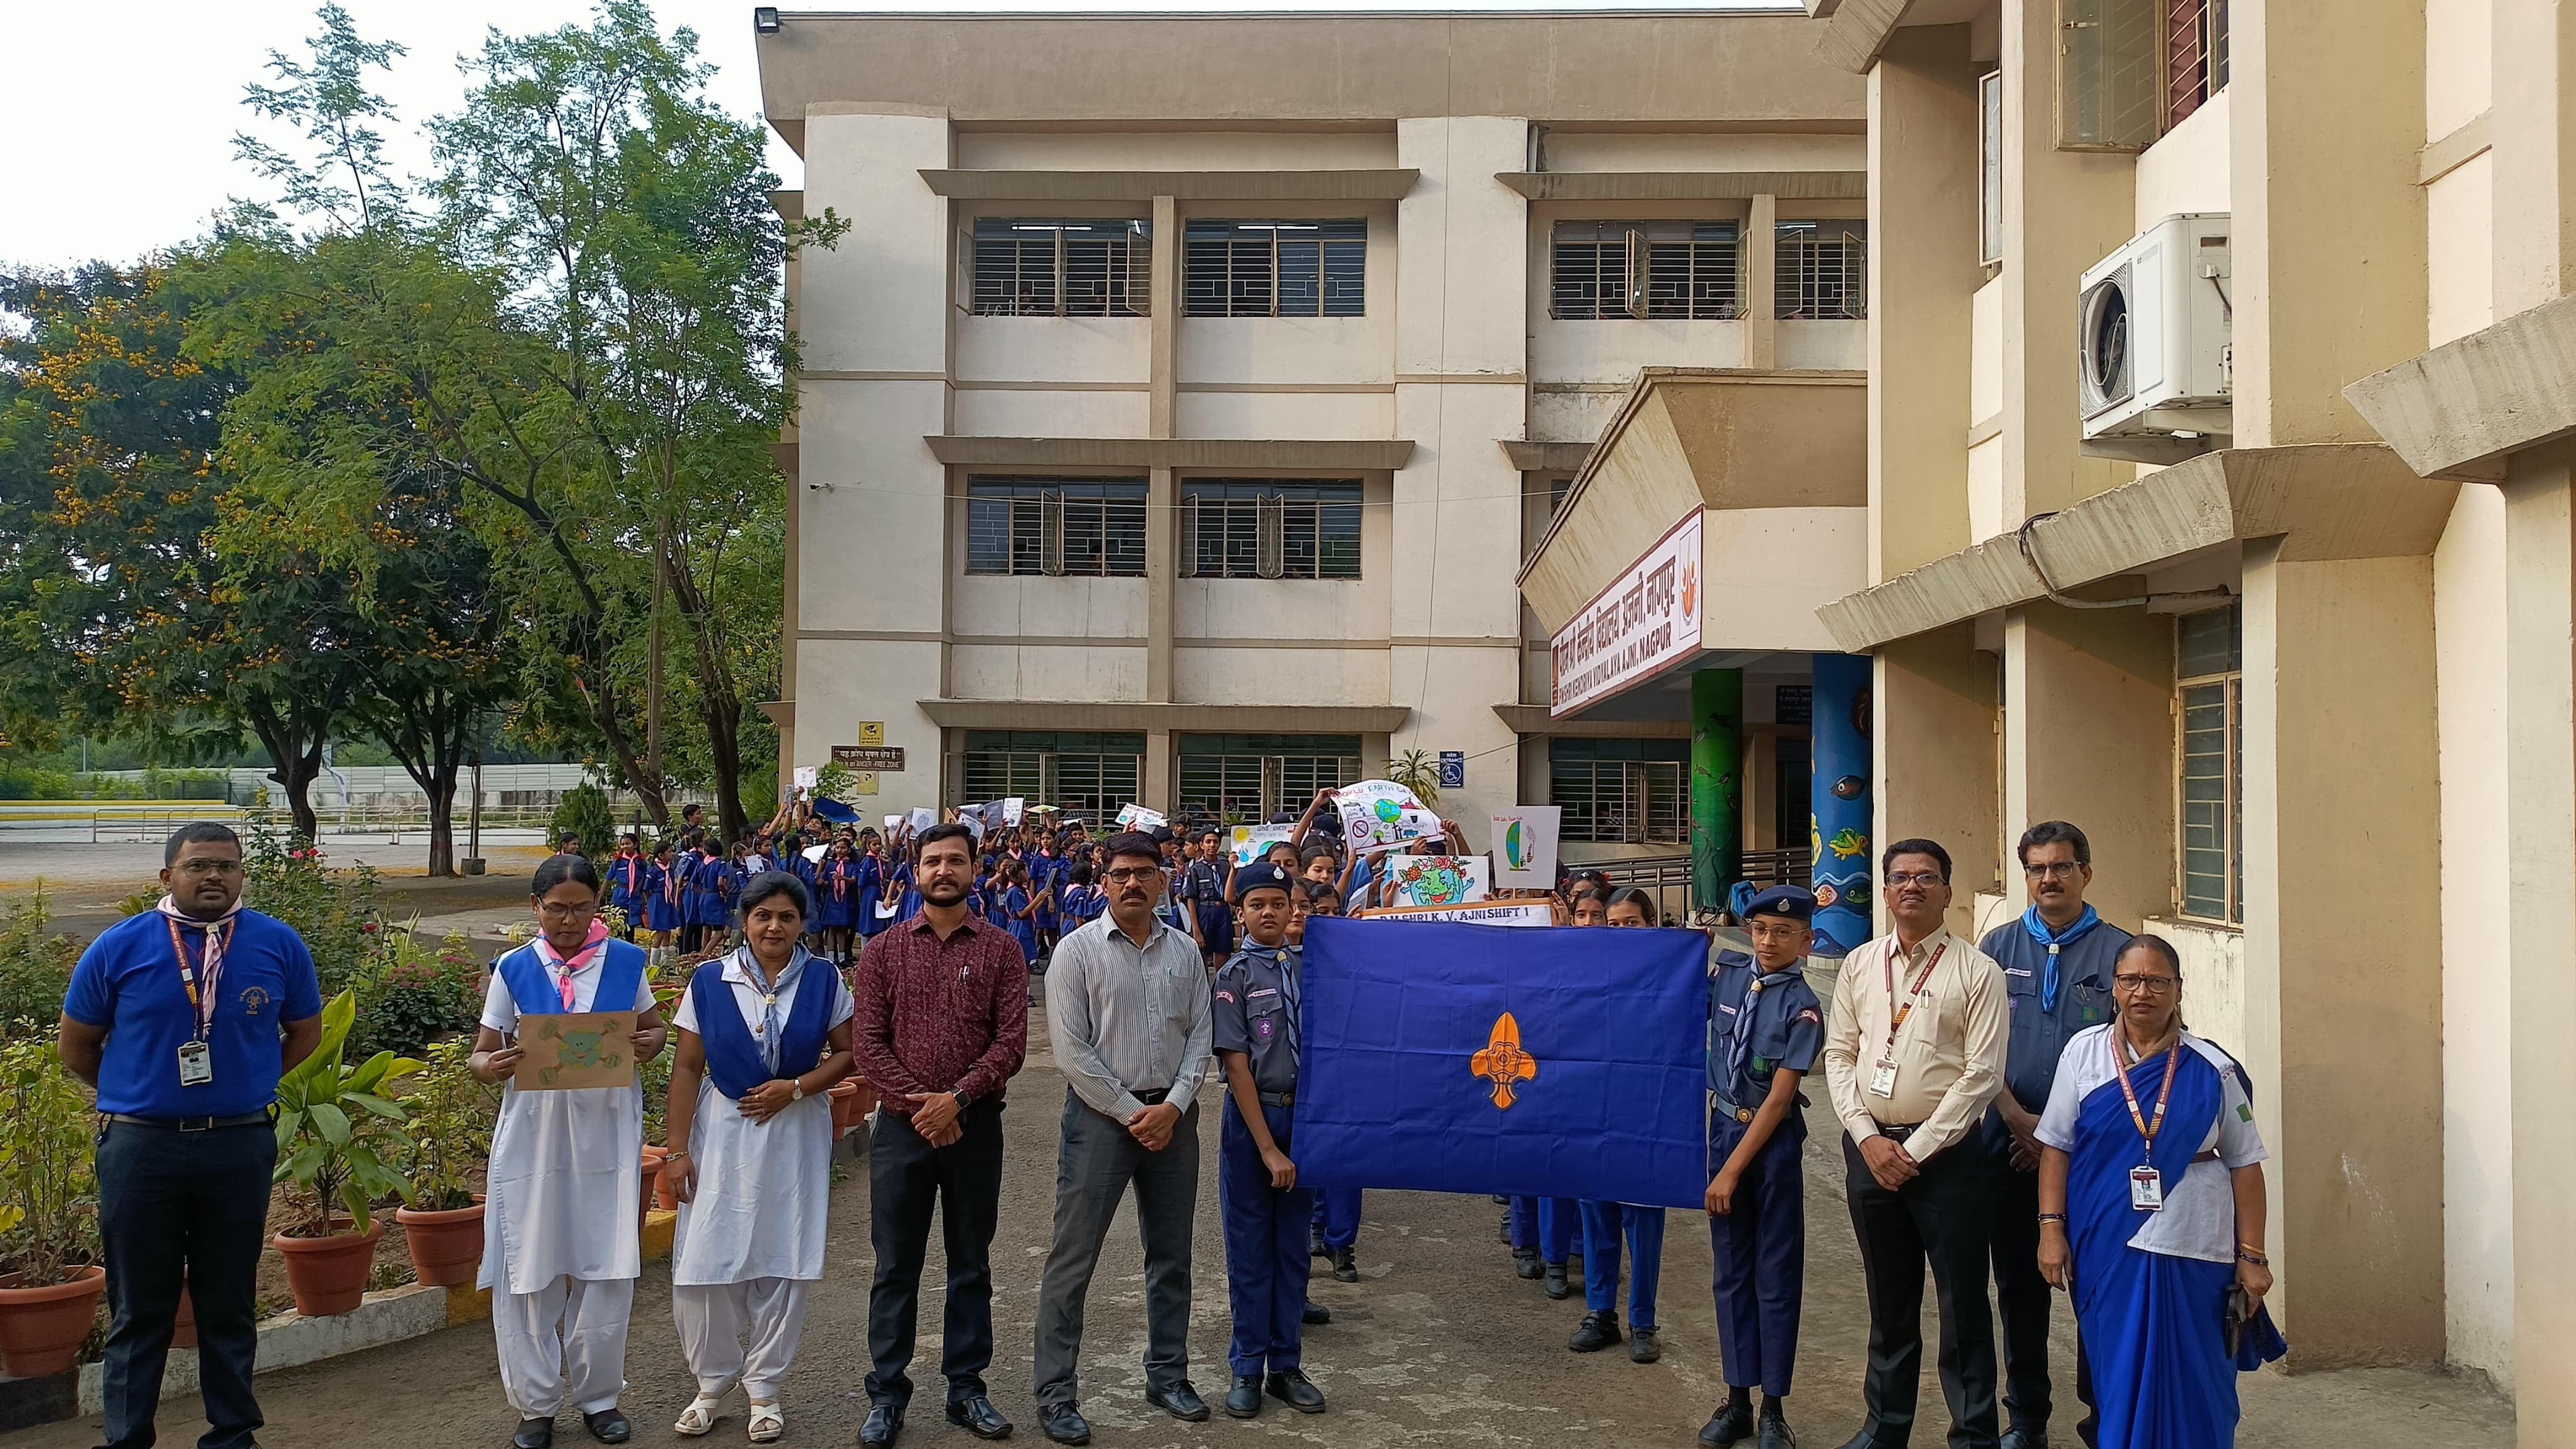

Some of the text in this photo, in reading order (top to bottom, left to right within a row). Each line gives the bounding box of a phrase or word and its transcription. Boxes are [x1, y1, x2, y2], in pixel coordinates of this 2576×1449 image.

[1596, 600, 1620, 654] विद्यालय
[1647, 555, 1676, 618] नागपुर
[1573, 669, 1593, 697] KENDRIYA
[1593, 652, 1621, 687] VIDYALAYA
[1622, 642, 1639, 672] AJNI,
[1640, 621, 1671, 664] NAGPUR
[1368, 784, 1394, 792] EARTH
[1460, 910, 1486, 920] AJNI
[1487, 907, 1520, 918] SHIFT
[1524, 907, 1529, 916] 1
